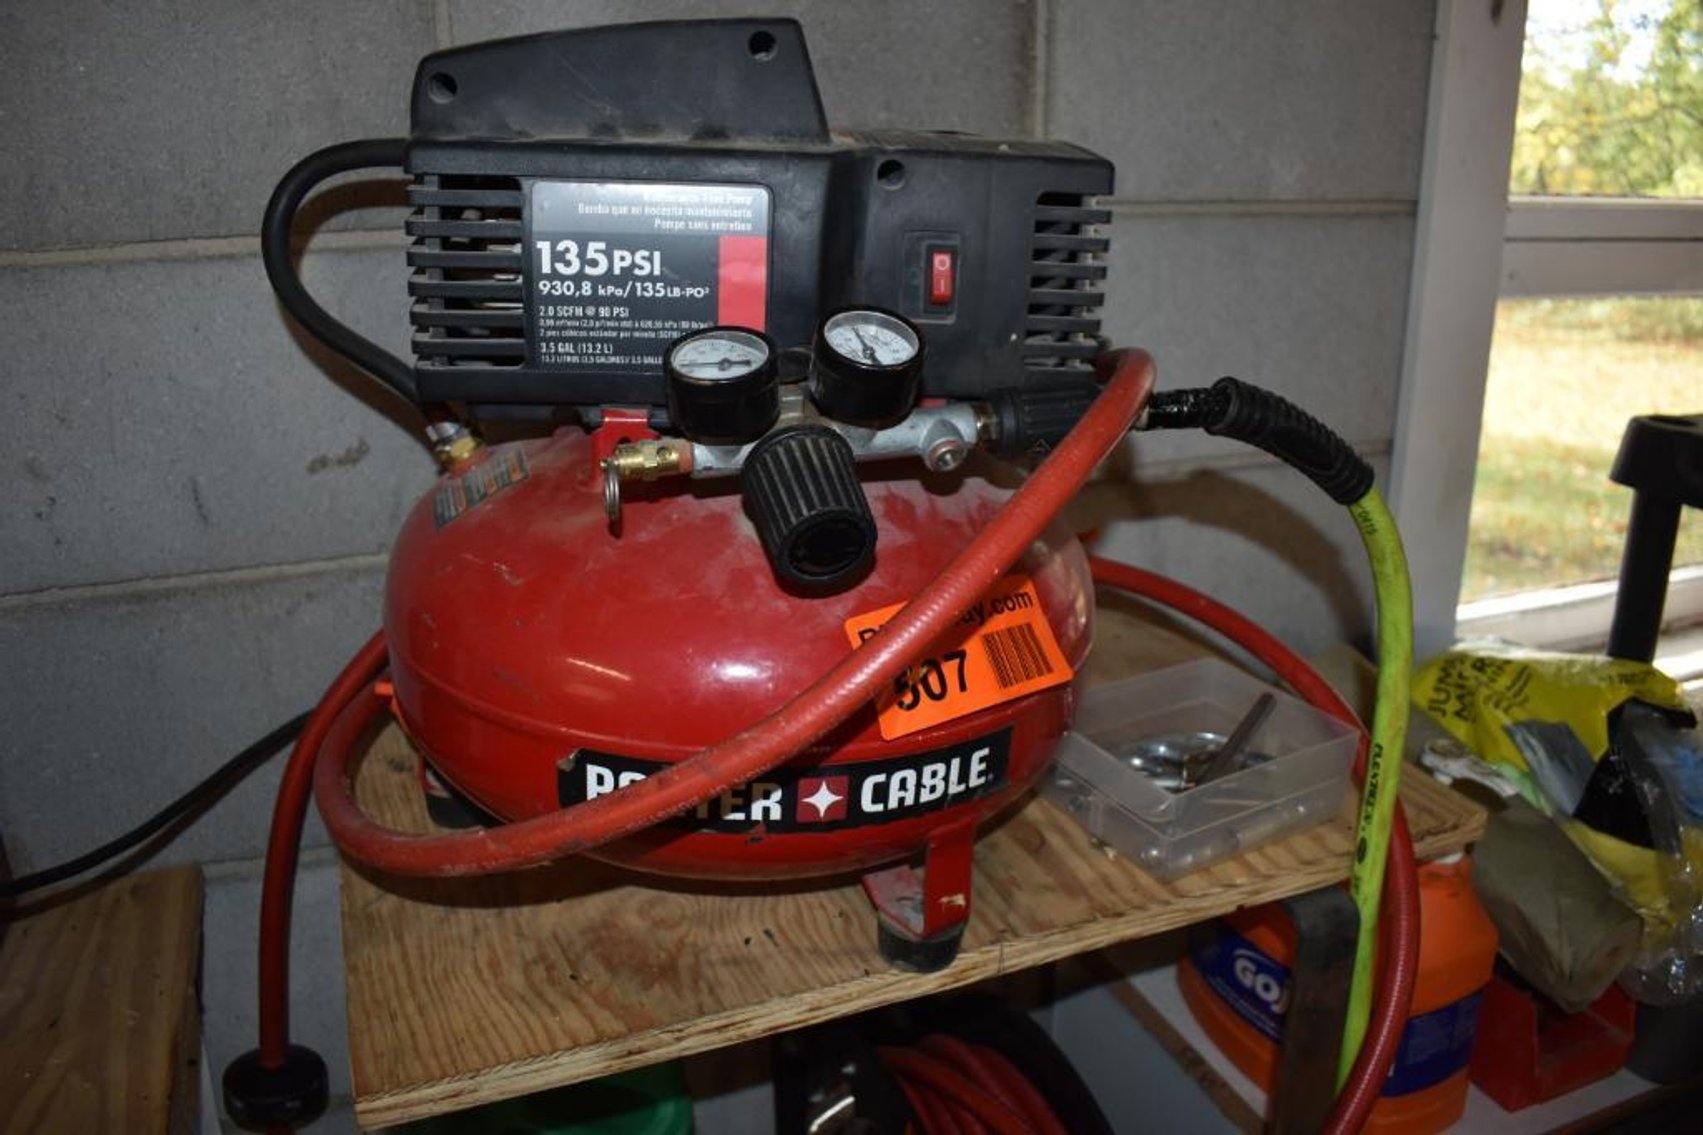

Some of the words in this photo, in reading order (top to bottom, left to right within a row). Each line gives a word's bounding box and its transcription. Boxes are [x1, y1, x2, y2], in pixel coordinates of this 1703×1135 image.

[537, 240, 609, 276] 135
[613, 249, 661, 276] PSI
[538, 281, 592, 298] 930,8
[557, 306, 583, 317] SCFM
[598, 306, 611, 317] 90
[613, 307, 630, 317] PSI
[558, 342, 575, 353] GAL
[586, 763, 783, 821] PTER
[861, 747, 990, 813] CABLE
[1235, 957, 1290, 1014] GOJ
